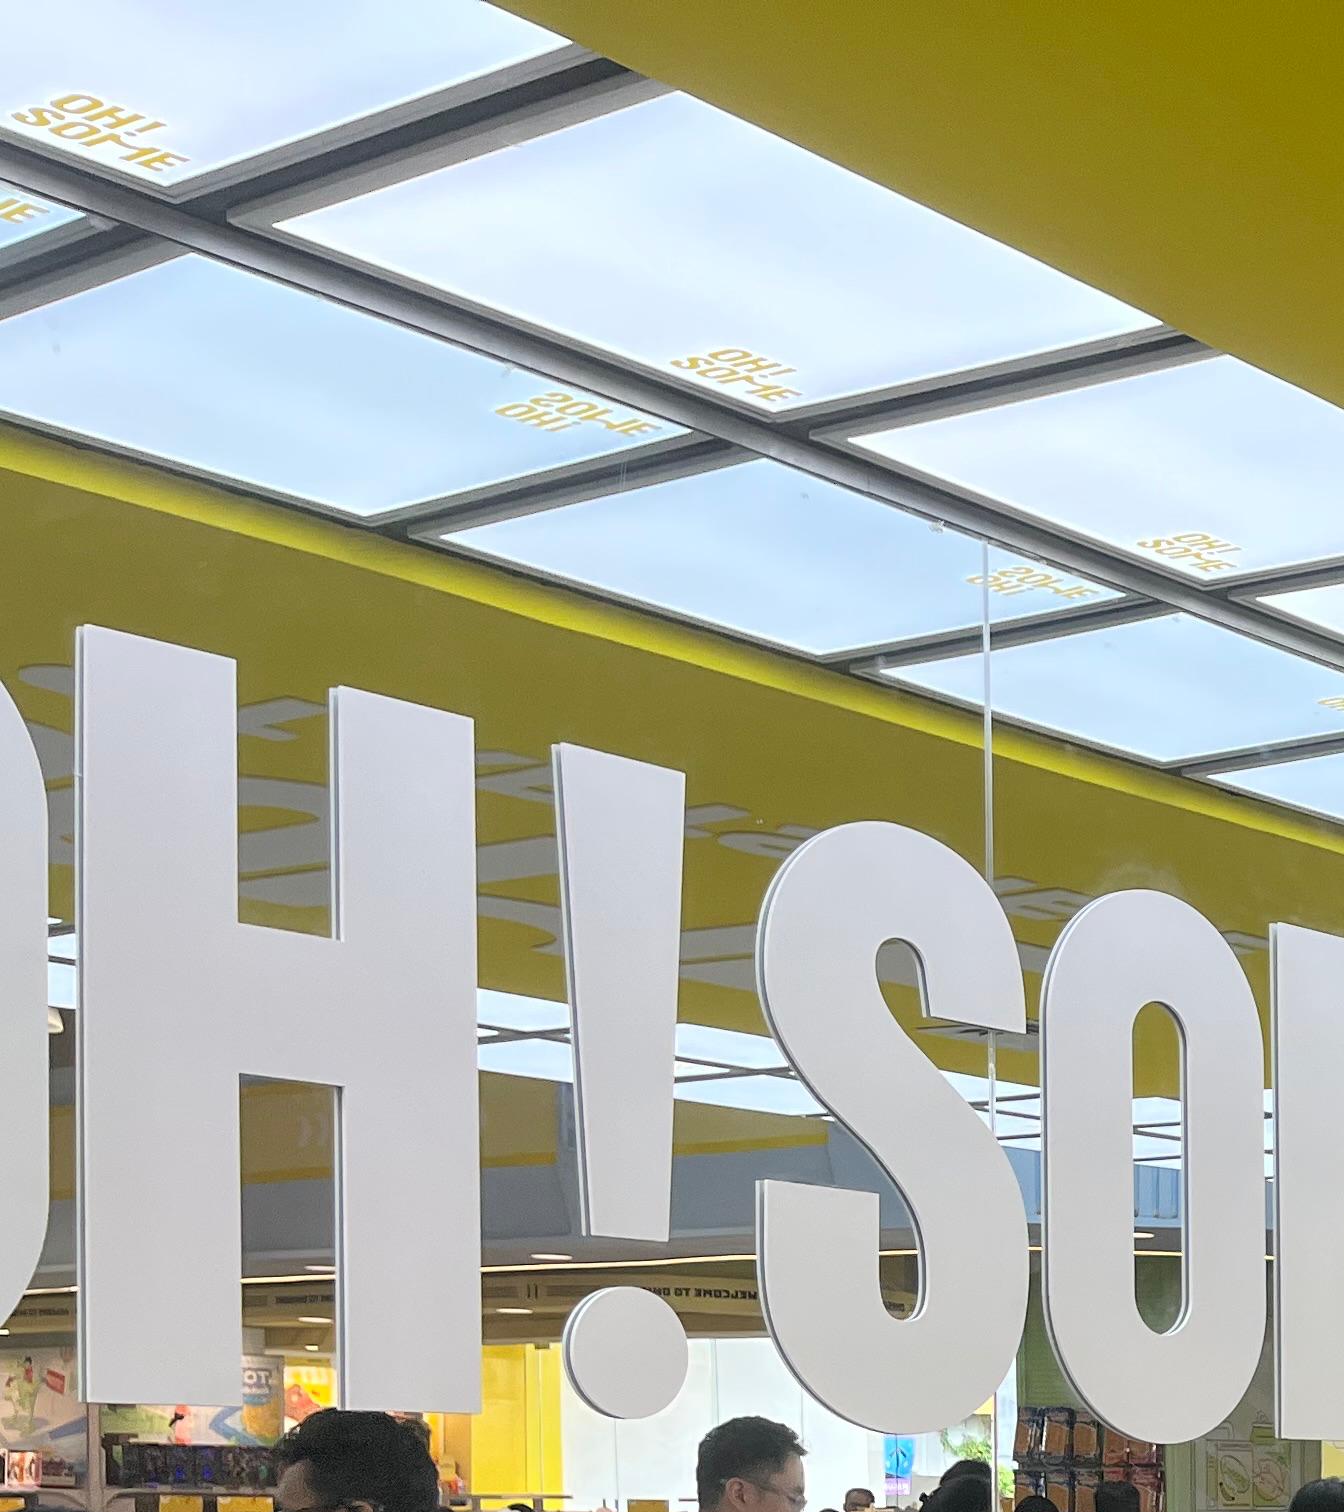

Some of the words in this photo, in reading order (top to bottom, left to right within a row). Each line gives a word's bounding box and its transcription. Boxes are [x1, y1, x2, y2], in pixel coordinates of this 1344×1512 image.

[50, 94, 167, 136] OH!
[11, 107, 191, 171] SOME
[670, 356, 803, 402] SOME
[708, 348, 797, 378] OH!
